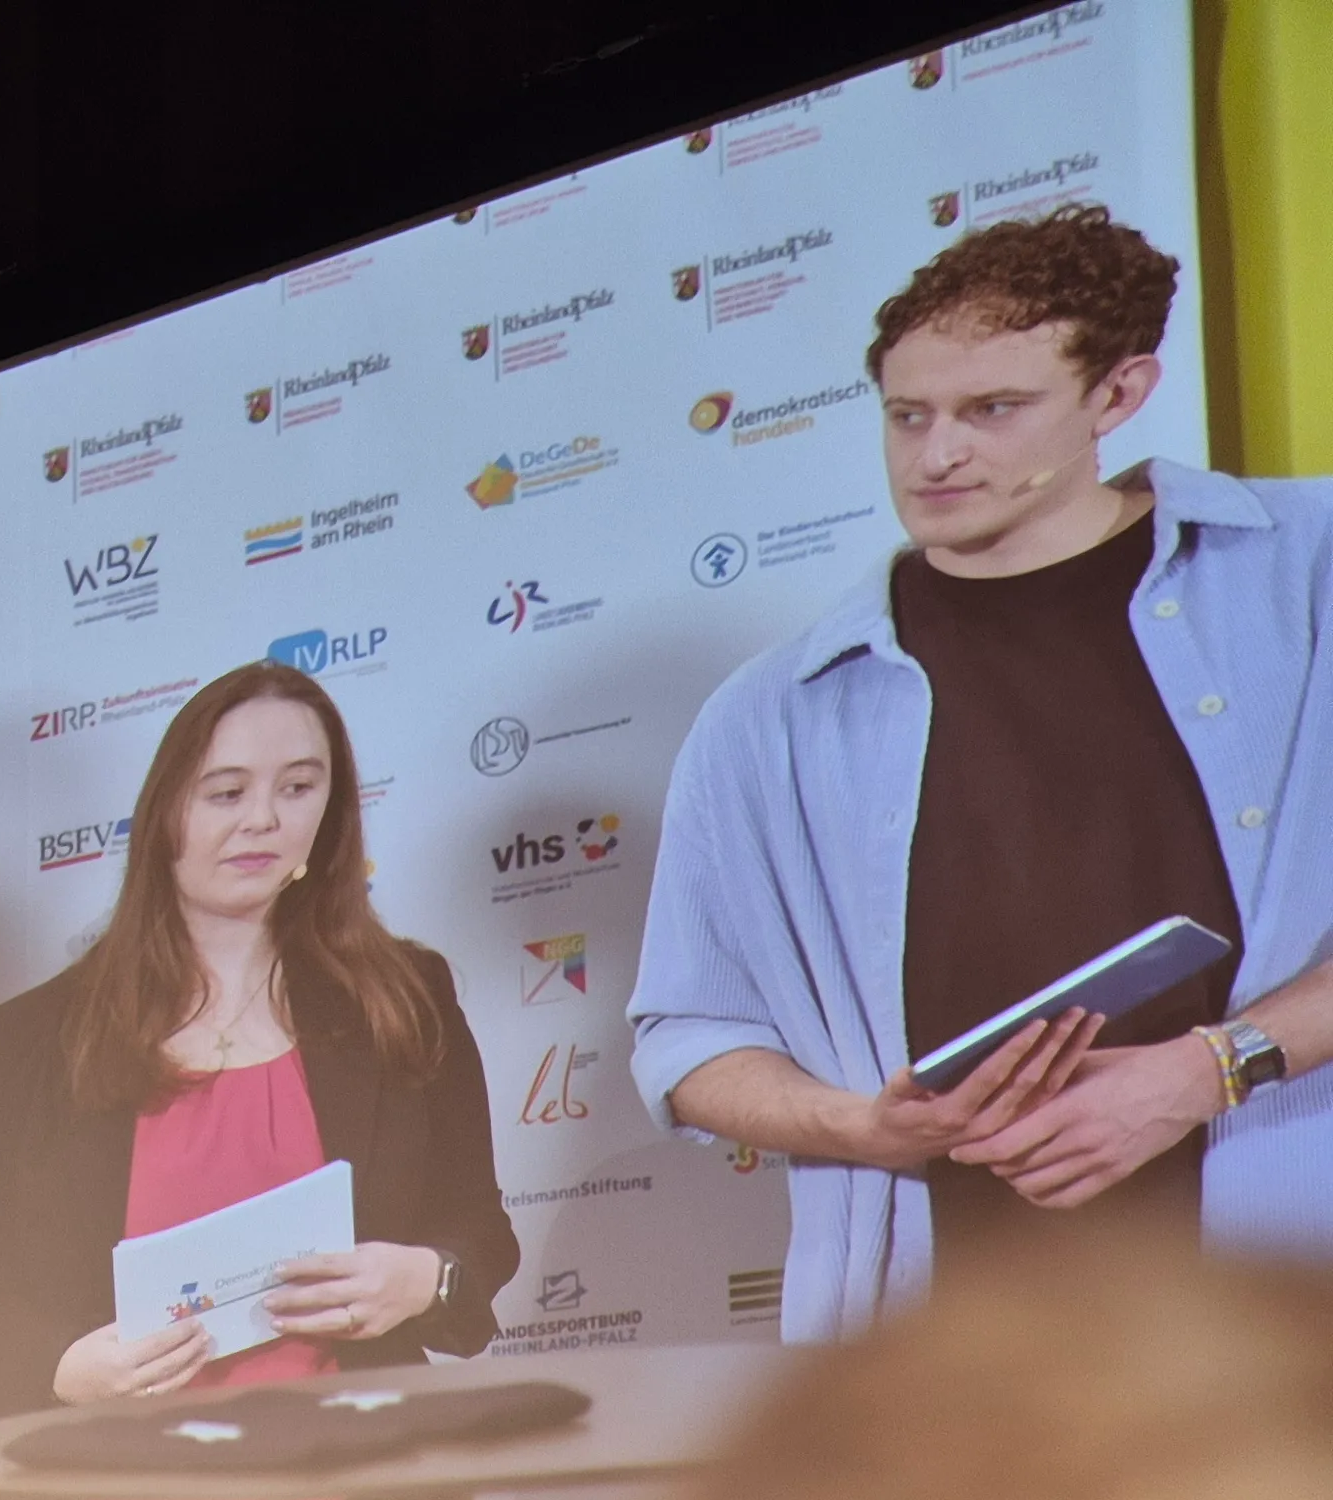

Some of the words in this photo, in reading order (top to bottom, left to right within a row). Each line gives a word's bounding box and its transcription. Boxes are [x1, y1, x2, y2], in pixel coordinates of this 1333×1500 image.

[732, 379, 869, 429] demokratisch
[732, 415, 815, 446] handeln
[520, 436, 601, 469] DeGeDe
[310, 491, 399, 528] Ingelheim
[310, 529, 339, 548] am
[342, 513, 393, 542] Rhein
[63, 534, 159, 596] WBZ
[39, 821, 114, 862] BSFV
[491, 833, 565, 874] vhs
[491, 1329, 637, 1358] RHEINLAND-PFALZ
[494, 1310, 642, 1341] ANDESSPORTBUND
